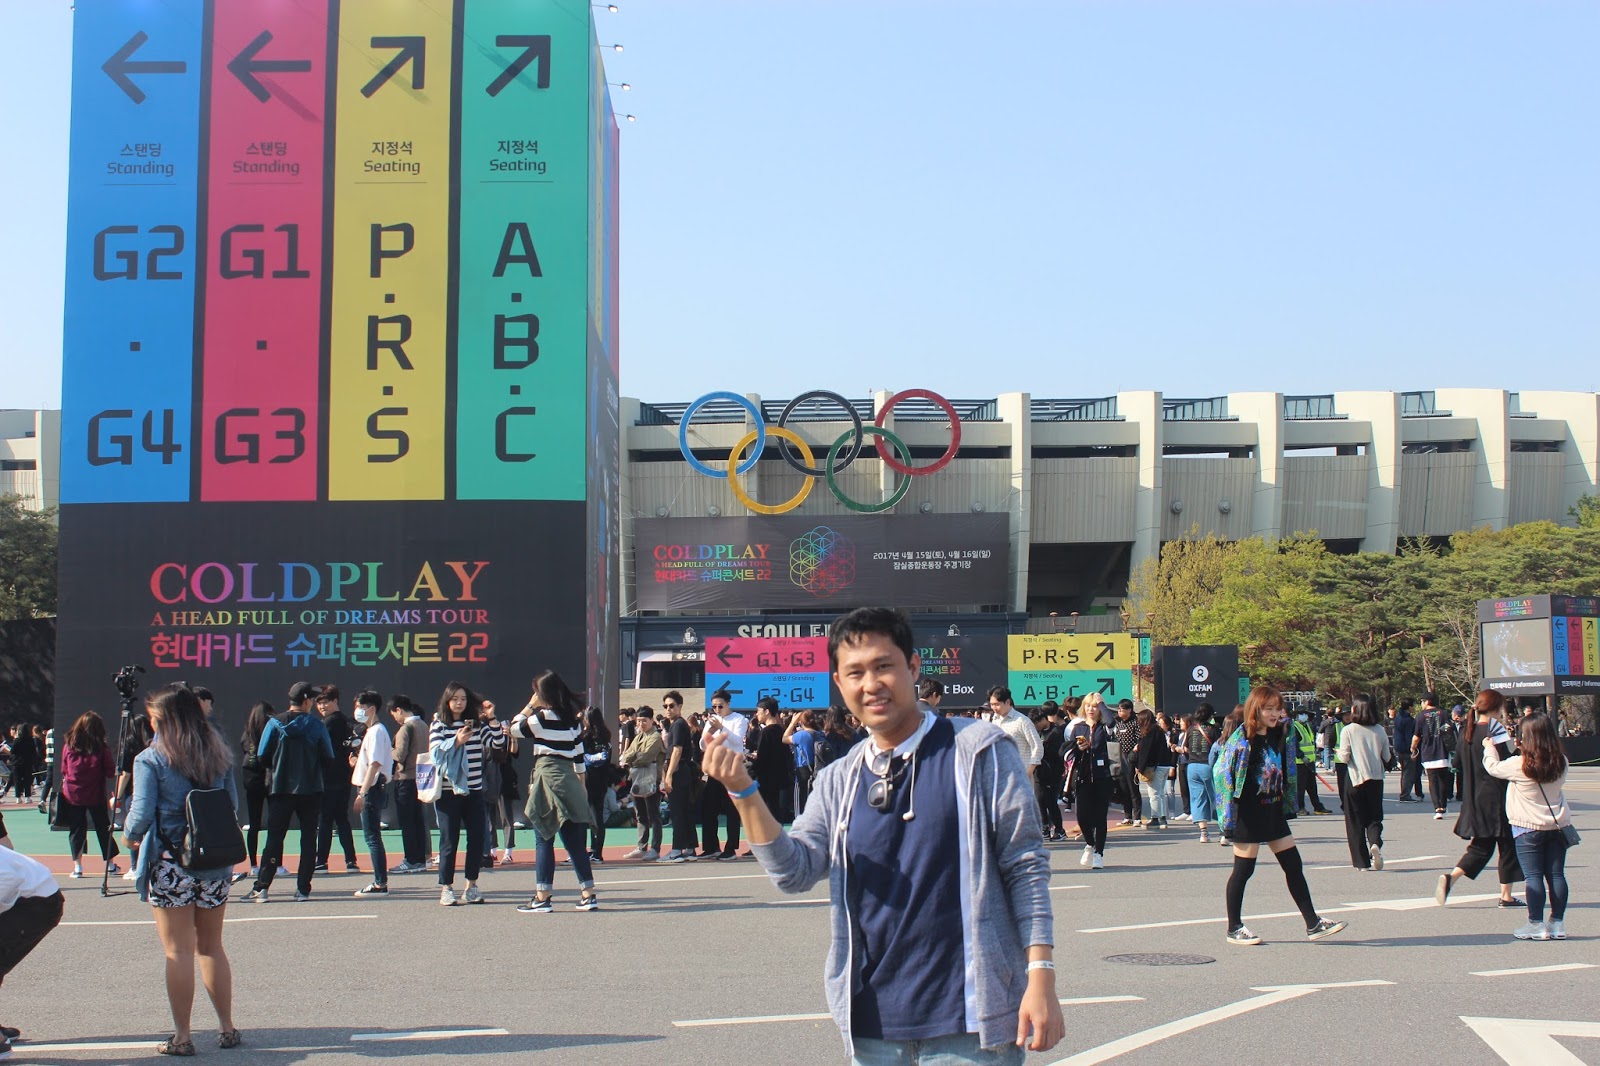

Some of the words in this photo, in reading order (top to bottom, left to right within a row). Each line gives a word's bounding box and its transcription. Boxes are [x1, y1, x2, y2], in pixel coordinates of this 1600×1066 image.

[120, 142, 163, 158] 스탠딩
[245, 141, 288, 157] 스탠딩
[371, 141, 414, 156] 지정석
[497, 140, 539, 155] 지정석
[107, 159, 174, 177] Standing
[233, 159, 300, 177] Standing
[364, 159, 420, 176] Seating
[489, 158, 547, 175] Seating
[93, 225, 185, 281] G2
[219, 224, 310, 279] G1
[87, 408, 182, 466] G4
[214, 407, 306, 465] G3
[653, 544, 771, 560] COLDPLAY
[873, 551, 899, 560] 2017년
[901, 551, 914, 559] 4월
[948, 550, 960, 558] 4월
[893, 560, 942, 570] 잠실종합운동장
[943, 560, 971, 569] 주경기장
[150, 561, 490, 604] COLDPLAY
[654, 569, 698, 582] 현대카드
[700, 569, 756, 581] 슈퍼콘서트
[756, 569, 772, 580] 22
[1494, 600, 1532, 608] COLDPLAY
[150, 612, 165, 627] A
[171, 611, 232, 626] HEAD
[237, 610, 294, 625] FULL
[300, 610, 329, 625] OF
[335, 609, 421, 625] DREAMS
[427, 609, 490, 624] TOUR
[150, 633, 276, 667] 현대카드
[285, 631, 442, 667] 슈퍼콘서트
[447, 632, 488, 662] 22
[1555, 643, 1565, 651] G2
[950, 665, 960, 674] 22
[1556, 665, 1566, 673] G4
[952, 684, 975, 694] Box
[1188, 684, 1213, 692] OXFAM
[1516, 680, 1545, 688] Information
